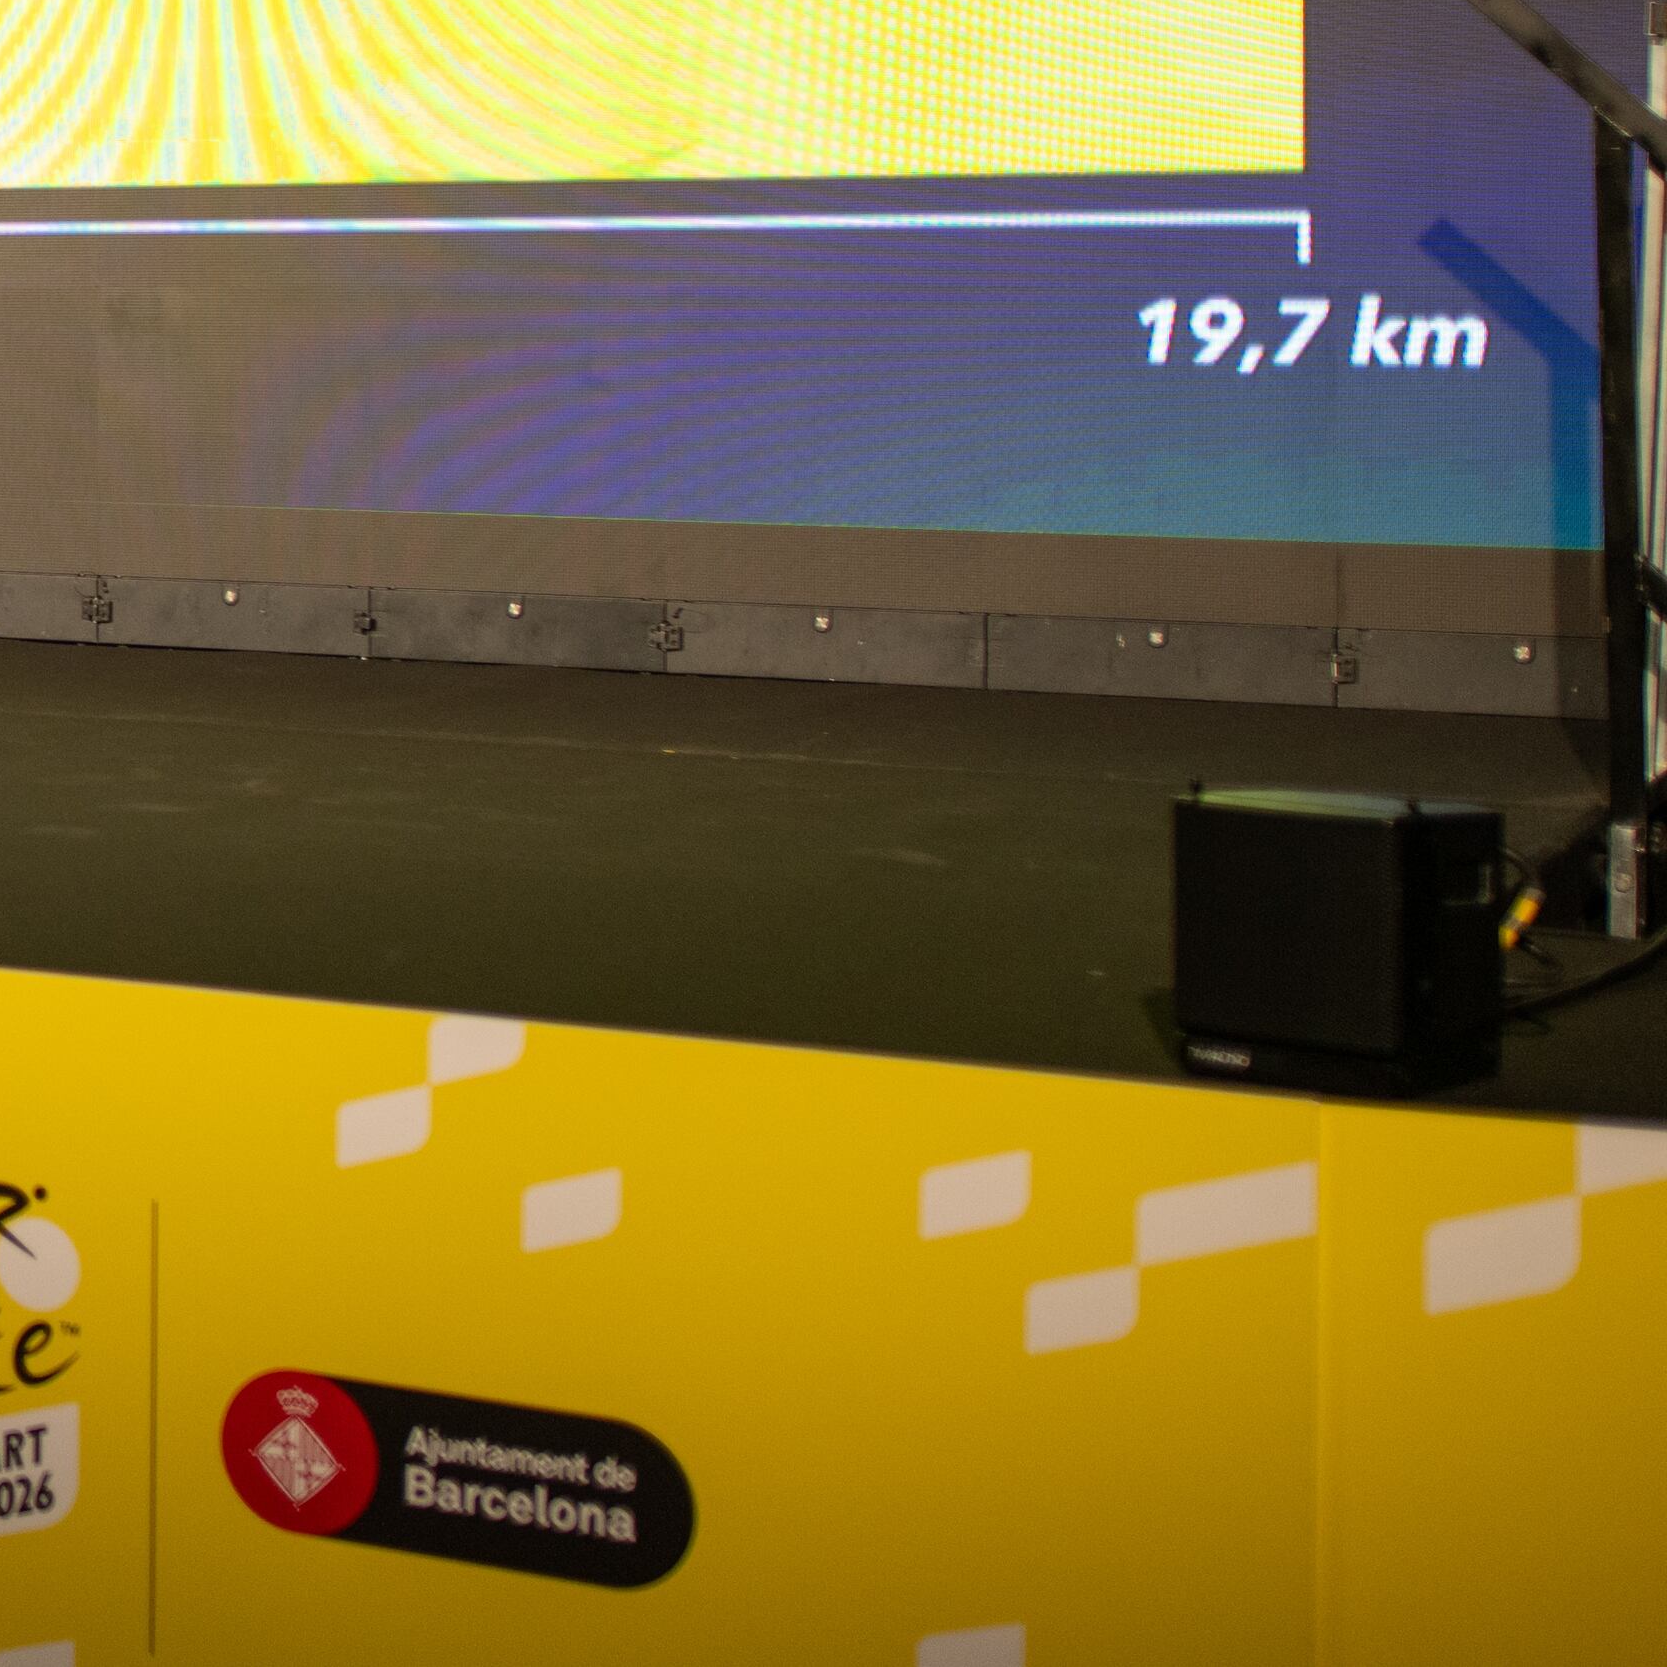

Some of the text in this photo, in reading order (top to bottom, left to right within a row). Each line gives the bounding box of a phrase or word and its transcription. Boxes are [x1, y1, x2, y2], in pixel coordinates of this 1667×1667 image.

[1138, 292, 1488, 374] 19,7 km
[405, 1425, 636, 1493] Ajuntament de
[405, 1464, 636, 1543] Barcelona
